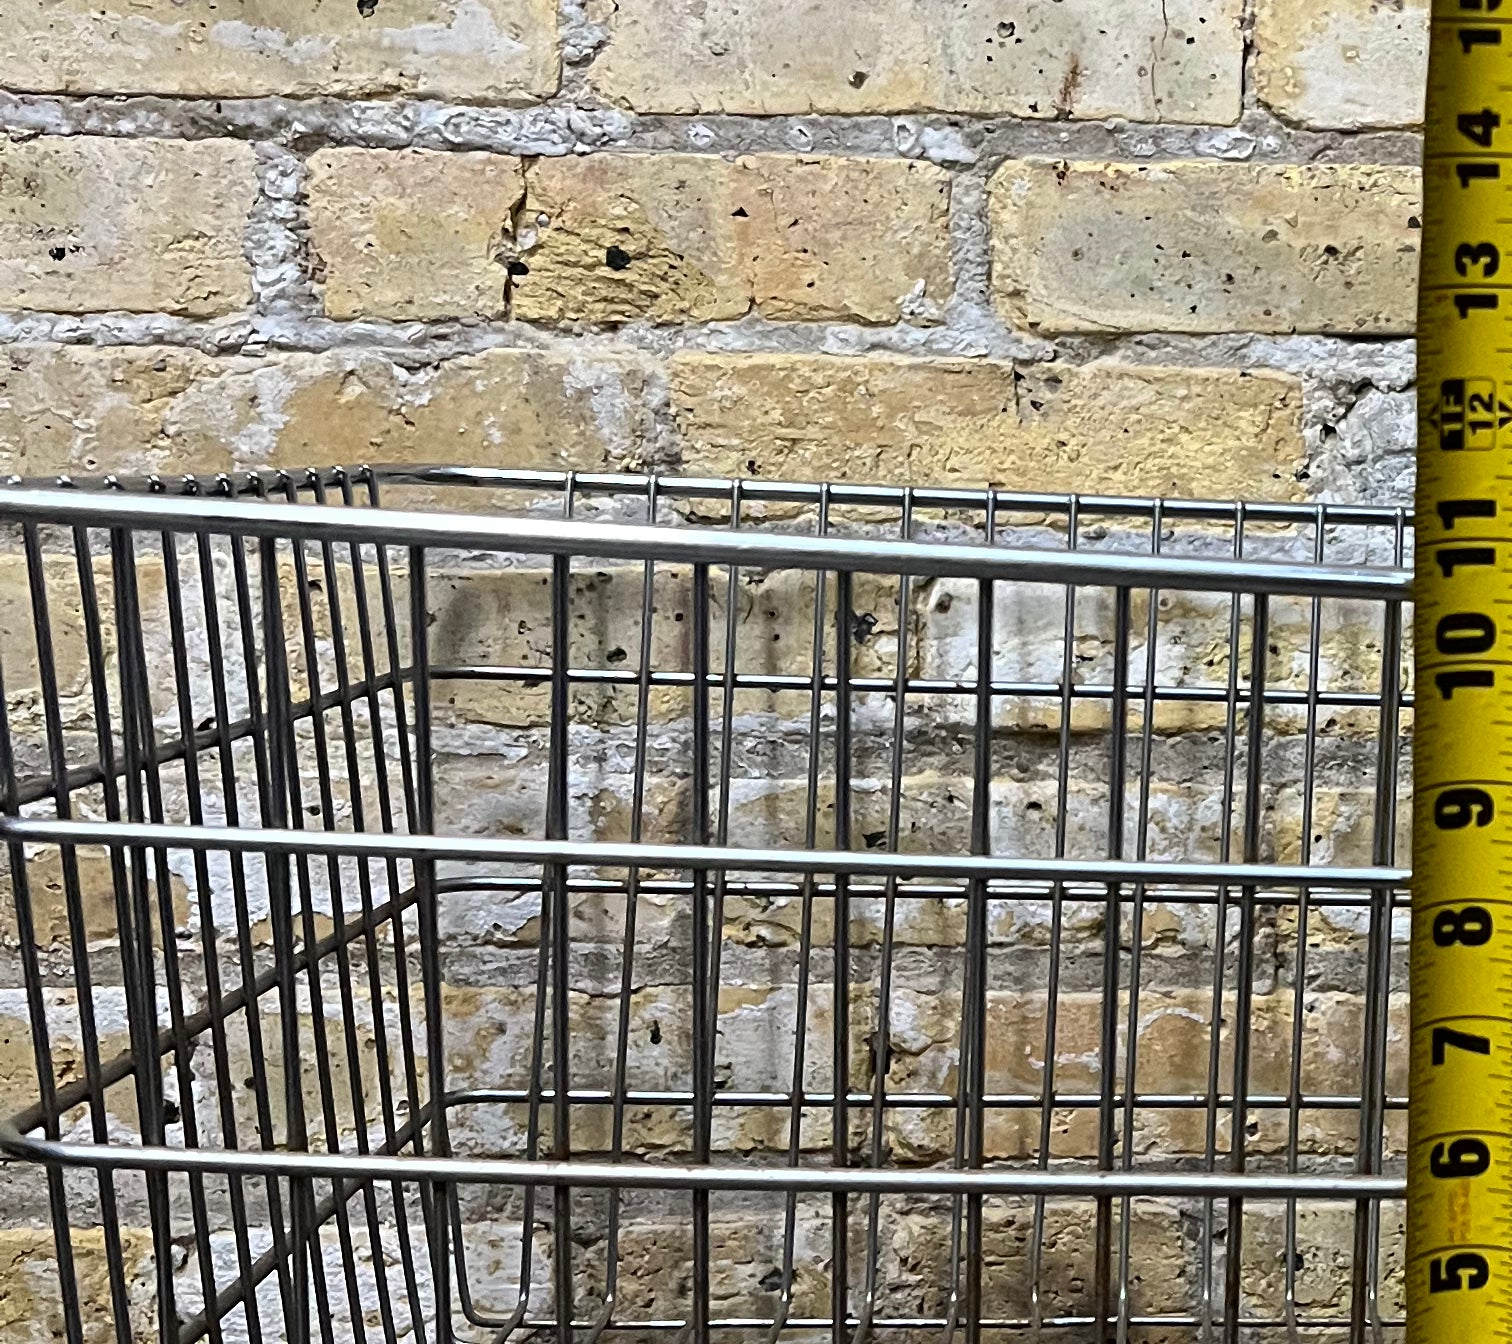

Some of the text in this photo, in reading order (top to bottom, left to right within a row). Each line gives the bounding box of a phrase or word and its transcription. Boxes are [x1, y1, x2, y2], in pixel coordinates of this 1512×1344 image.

[1456, 109, 1501, 189] 14
[1453, 242, 1500, 319] 13
[1469, 393, 1493, 436] 12
[1436, 499, 1497, 578] 11
[1435, 612, 1497, 700] 10
[1434, 788, 1495, 830] 9
[1432, 906, 1493, 948] 8
[1432, 1026, 1491, 1066] 7
[1430, 1138, 1491, 1179] 6
[1430, 1253, 1490, 1294] 5
